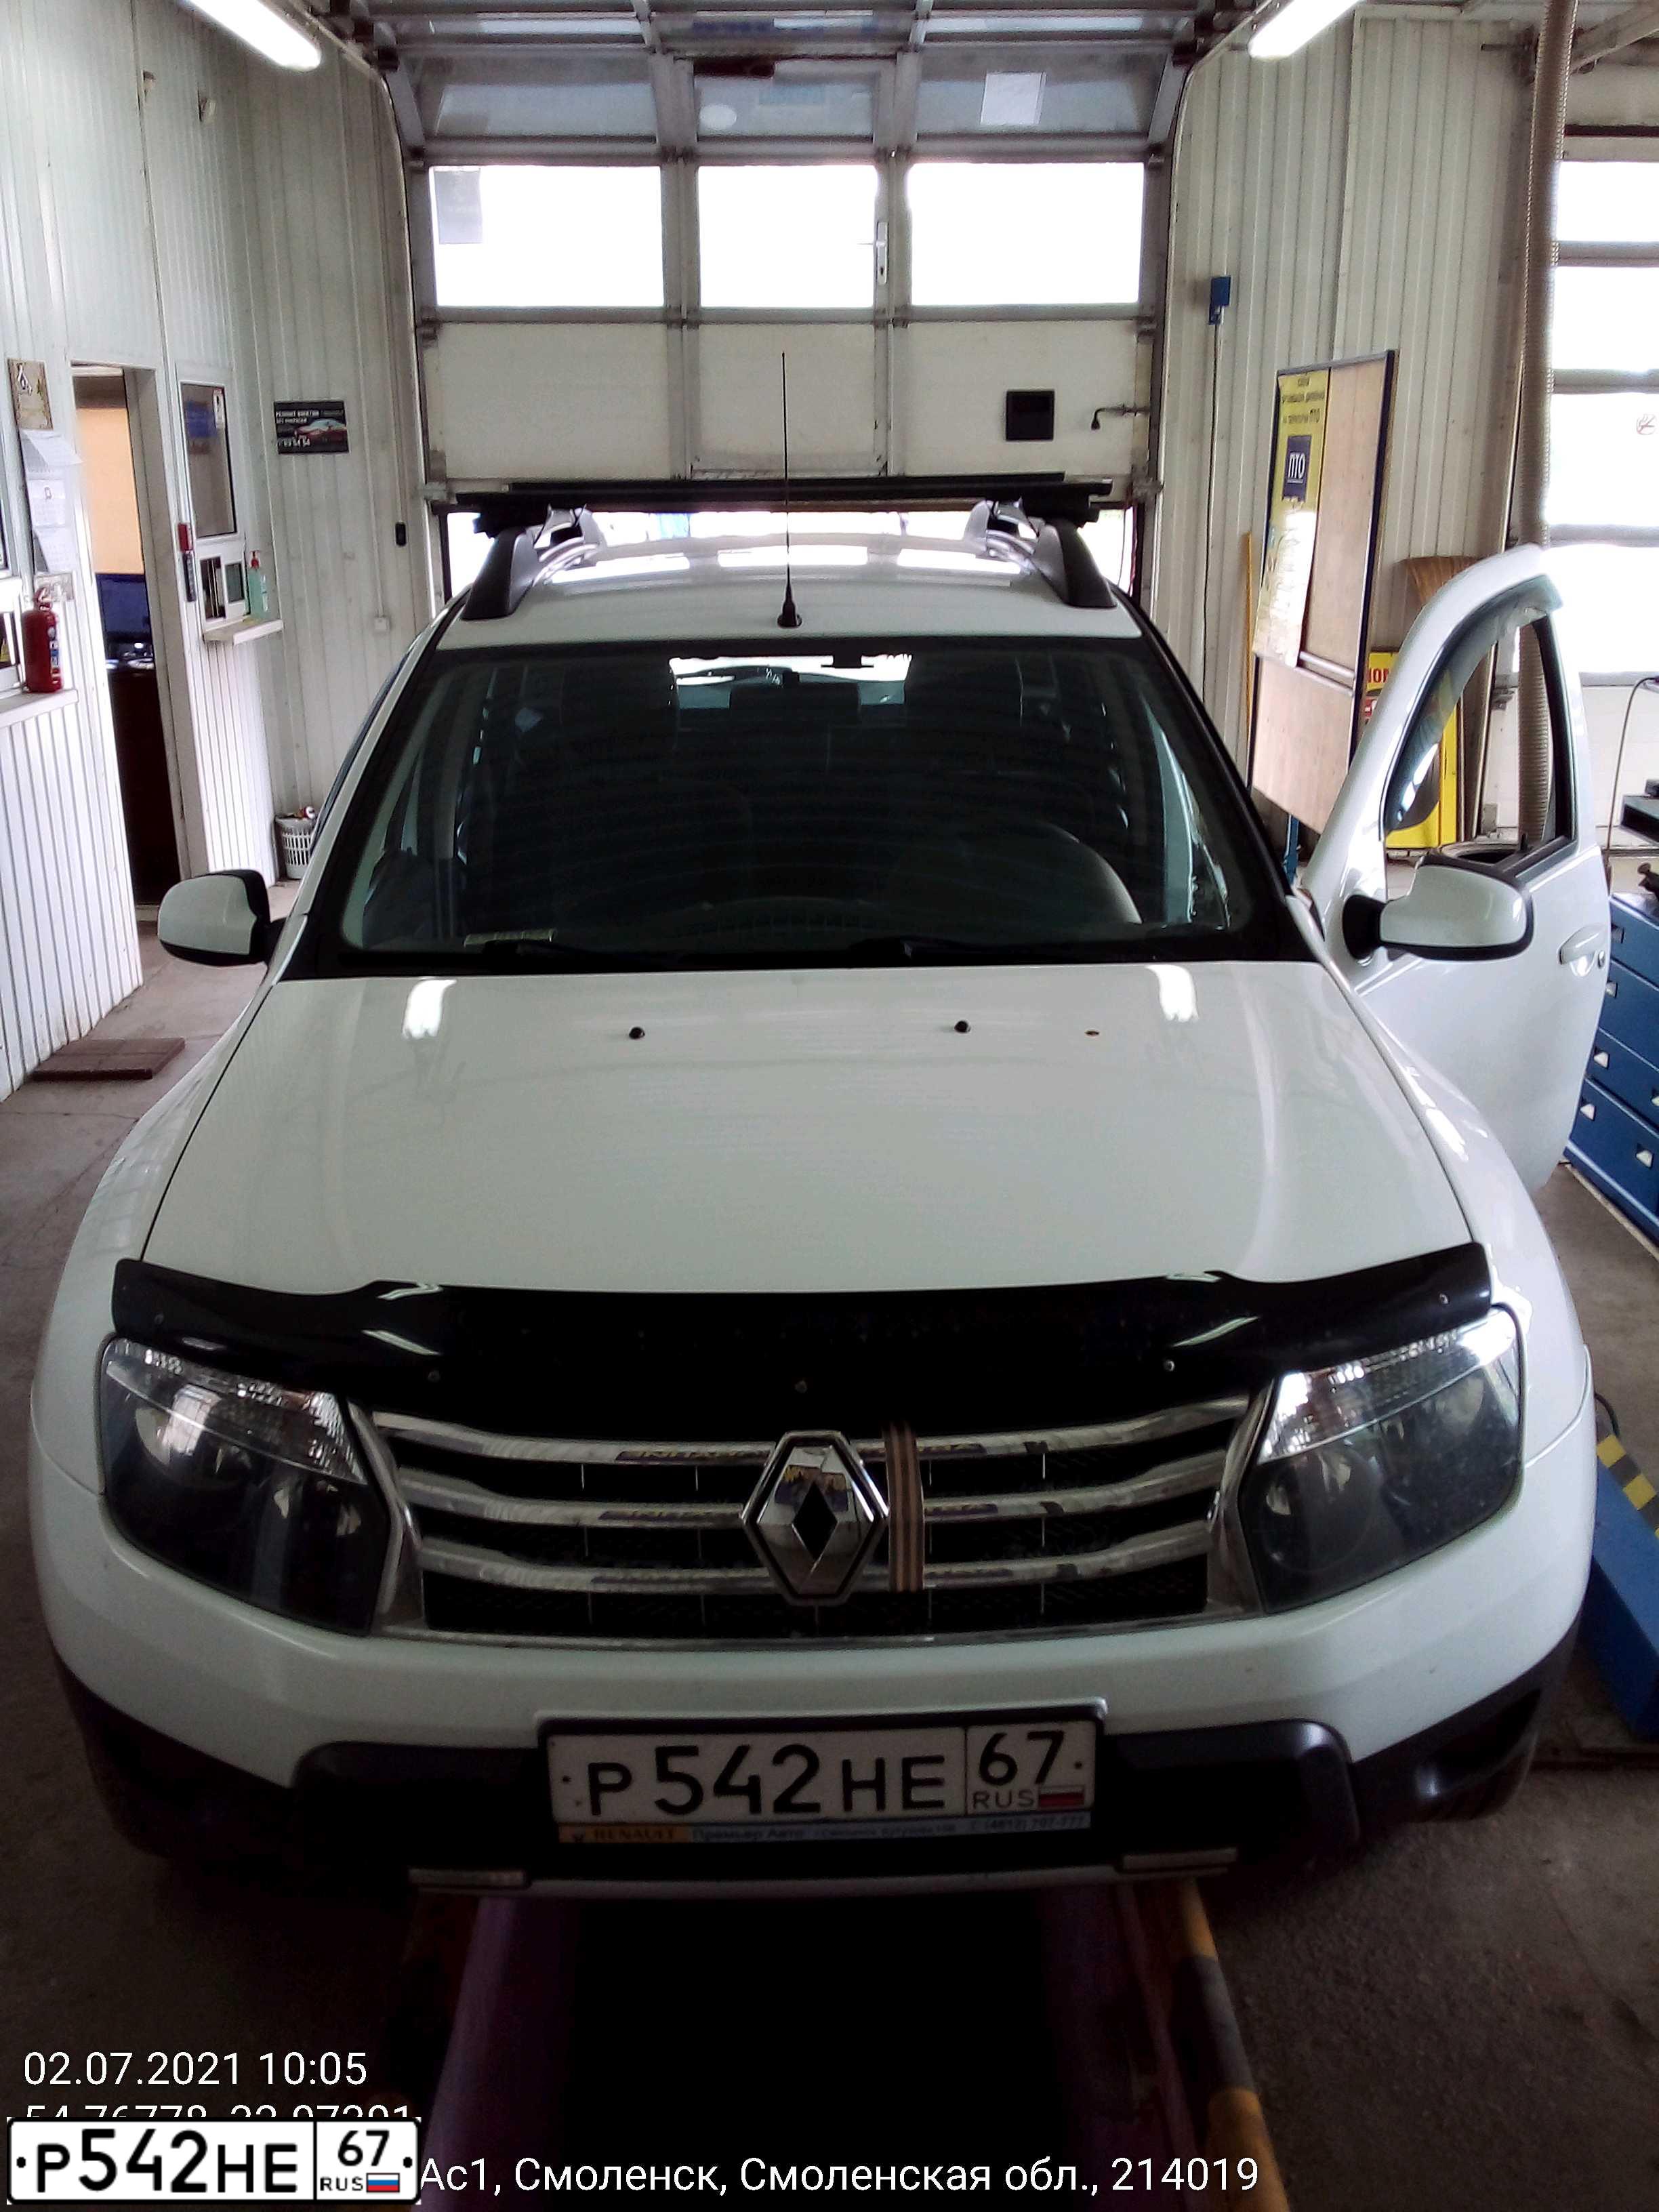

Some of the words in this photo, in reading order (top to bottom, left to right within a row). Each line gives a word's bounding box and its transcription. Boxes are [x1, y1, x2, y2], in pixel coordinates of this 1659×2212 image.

[1288, 451, 1306, 479] ПТО
[977, 1730, 1066, 1789] 67
[972, 1789, 1036, 1810] RUS
[593, 1827, 677, 1841] RENAULT
